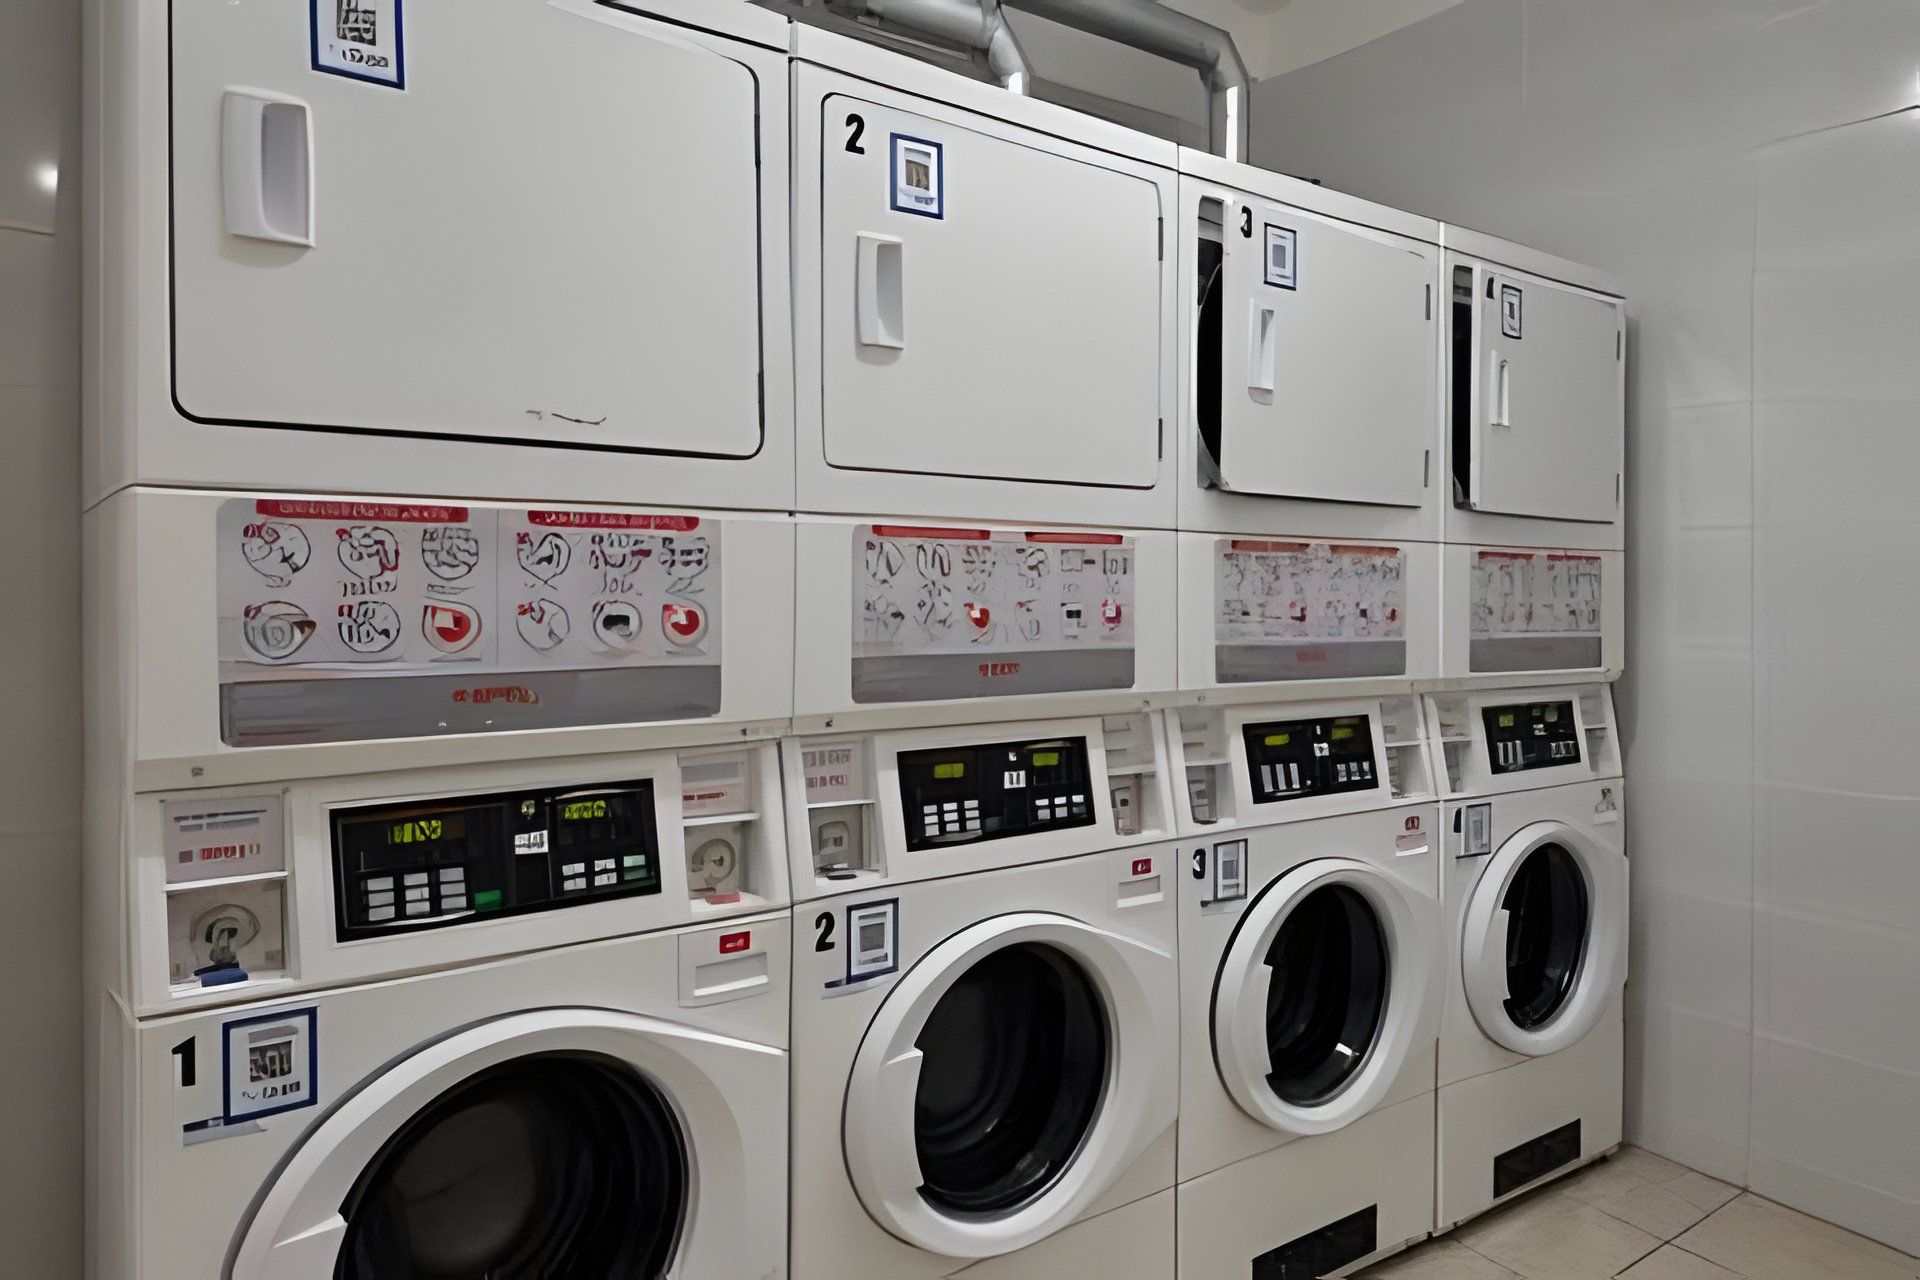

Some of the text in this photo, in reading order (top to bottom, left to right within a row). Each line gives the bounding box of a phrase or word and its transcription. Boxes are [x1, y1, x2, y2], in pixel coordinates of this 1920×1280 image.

[844, 113, 865, 155] 2
[814, 911, 836, 953] 2
[171, 1035, 196, 1088] 1
